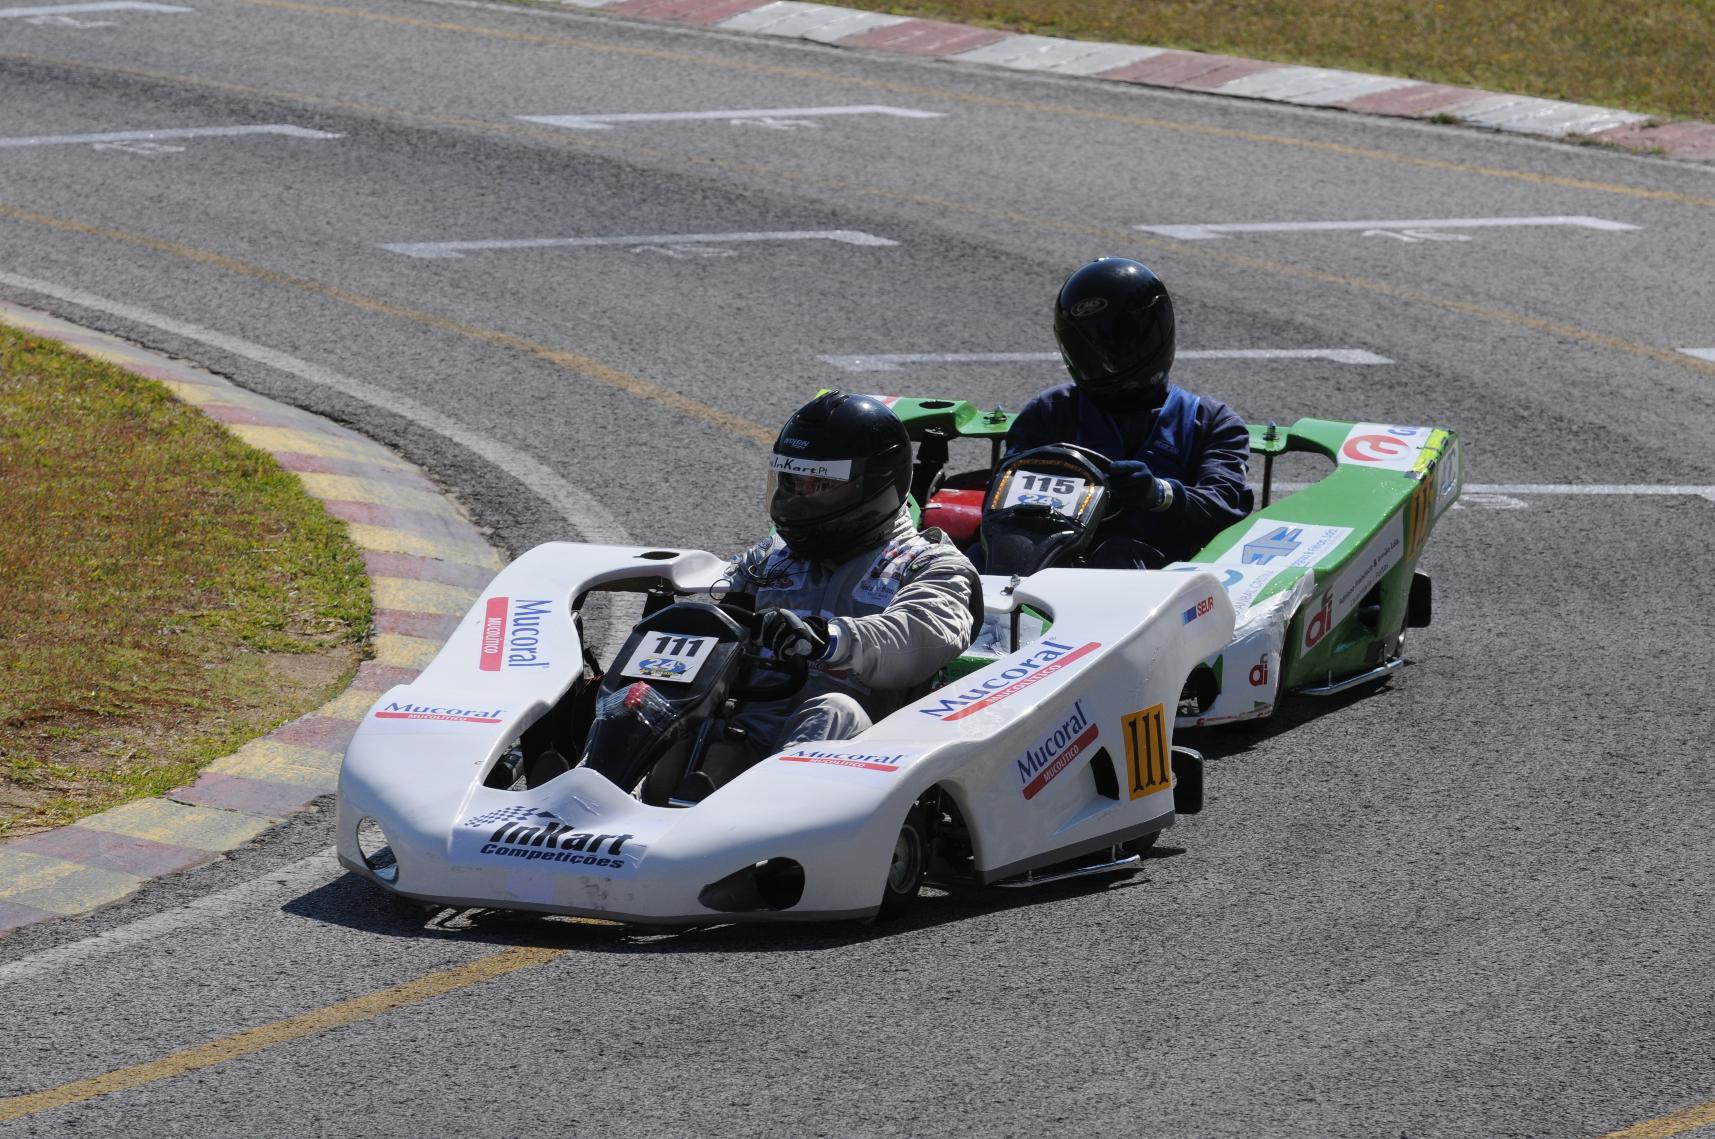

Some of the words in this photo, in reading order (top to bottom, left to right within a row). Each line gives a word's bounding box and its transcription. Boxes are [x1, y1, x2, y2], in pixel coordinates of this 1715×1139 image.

[1022, 475, 1075, 495] 115
[1197, 597, 1214, 617] SEUR
[508, 600, 552, 666] Mucoral
[653, 636, 704, 657] 111
[919, 641, 1074, 717] Mucoral
[384, 702, 500, 717] Mucoral
[1017, 699, 1088, 784] Mucoral
[1128, 711, 1169, 793] 111
[790, 750, 903, 764] Mucoral
[489, 821, 634, 856] InKart
[480, 843, 625, 869] Competições
